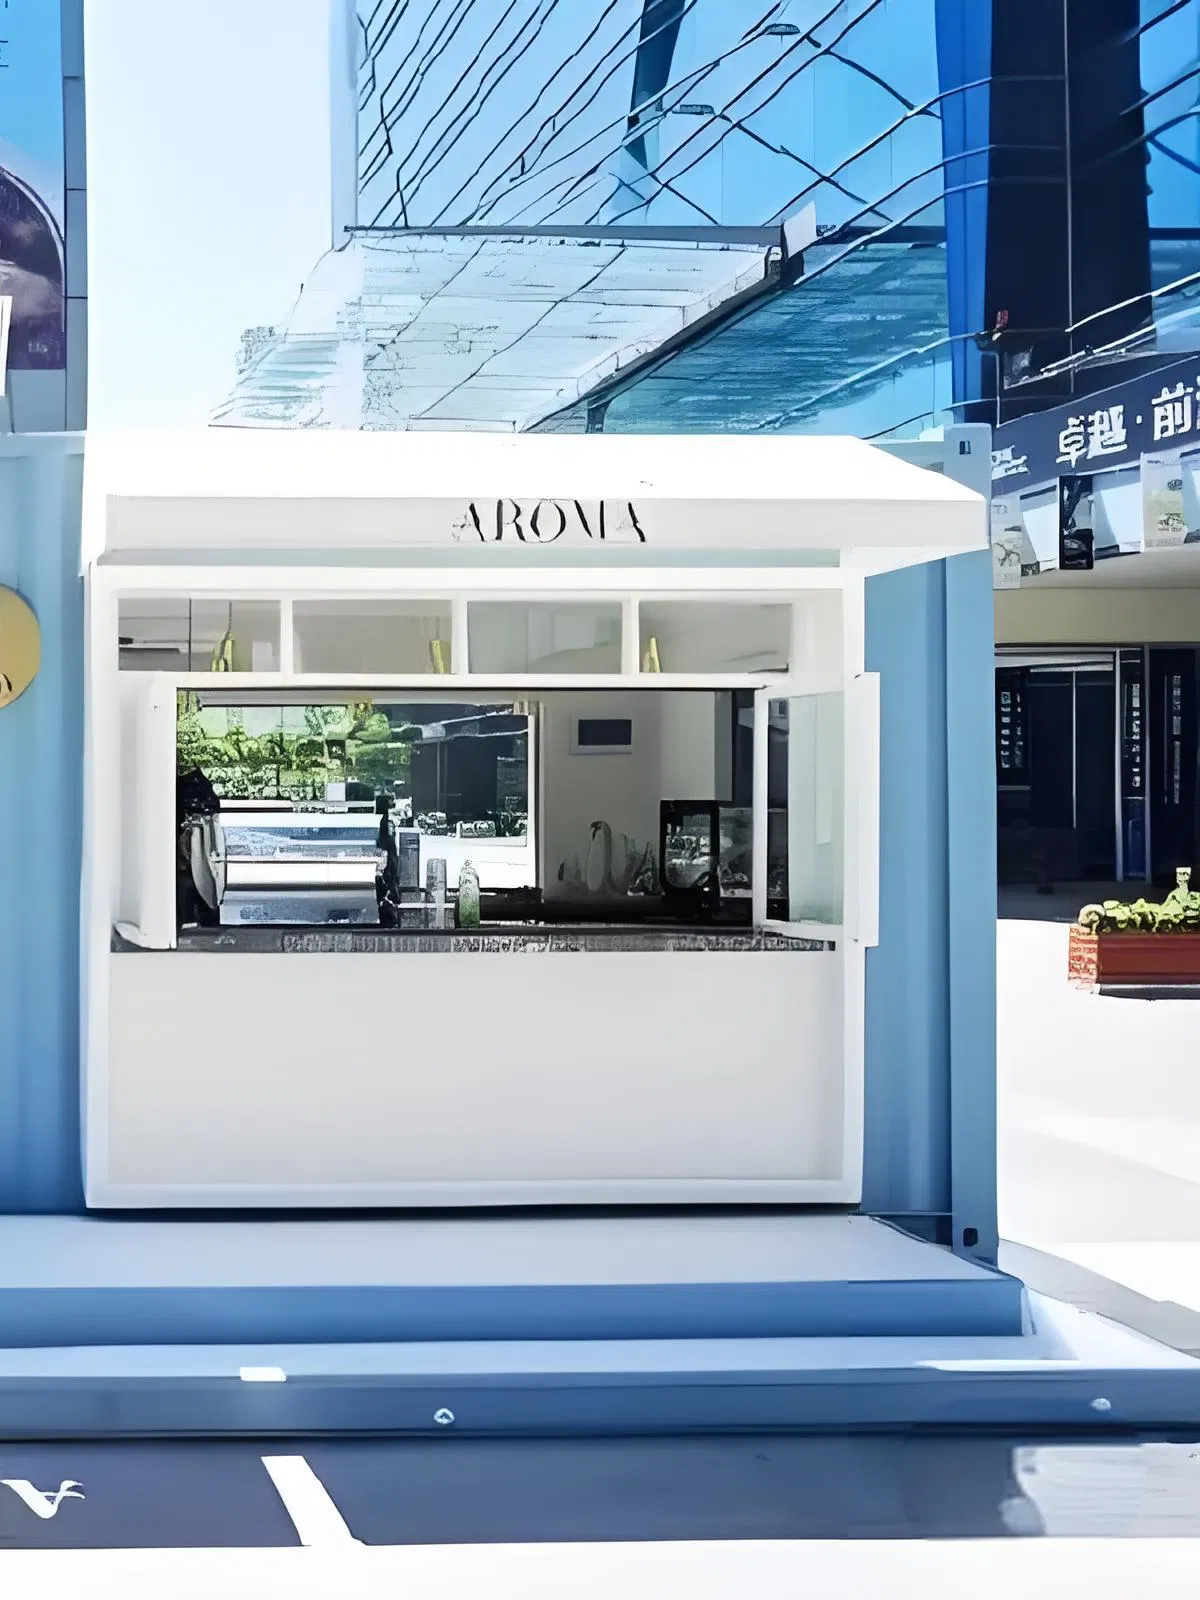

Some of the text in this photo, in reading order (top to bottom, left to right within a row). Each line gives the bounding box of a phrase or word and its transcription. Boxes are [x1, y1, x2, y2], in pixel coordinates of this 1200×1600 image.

[1056, 374, 1200, 469] 卓越·前
[451, 498, 646, 543] AROMA
